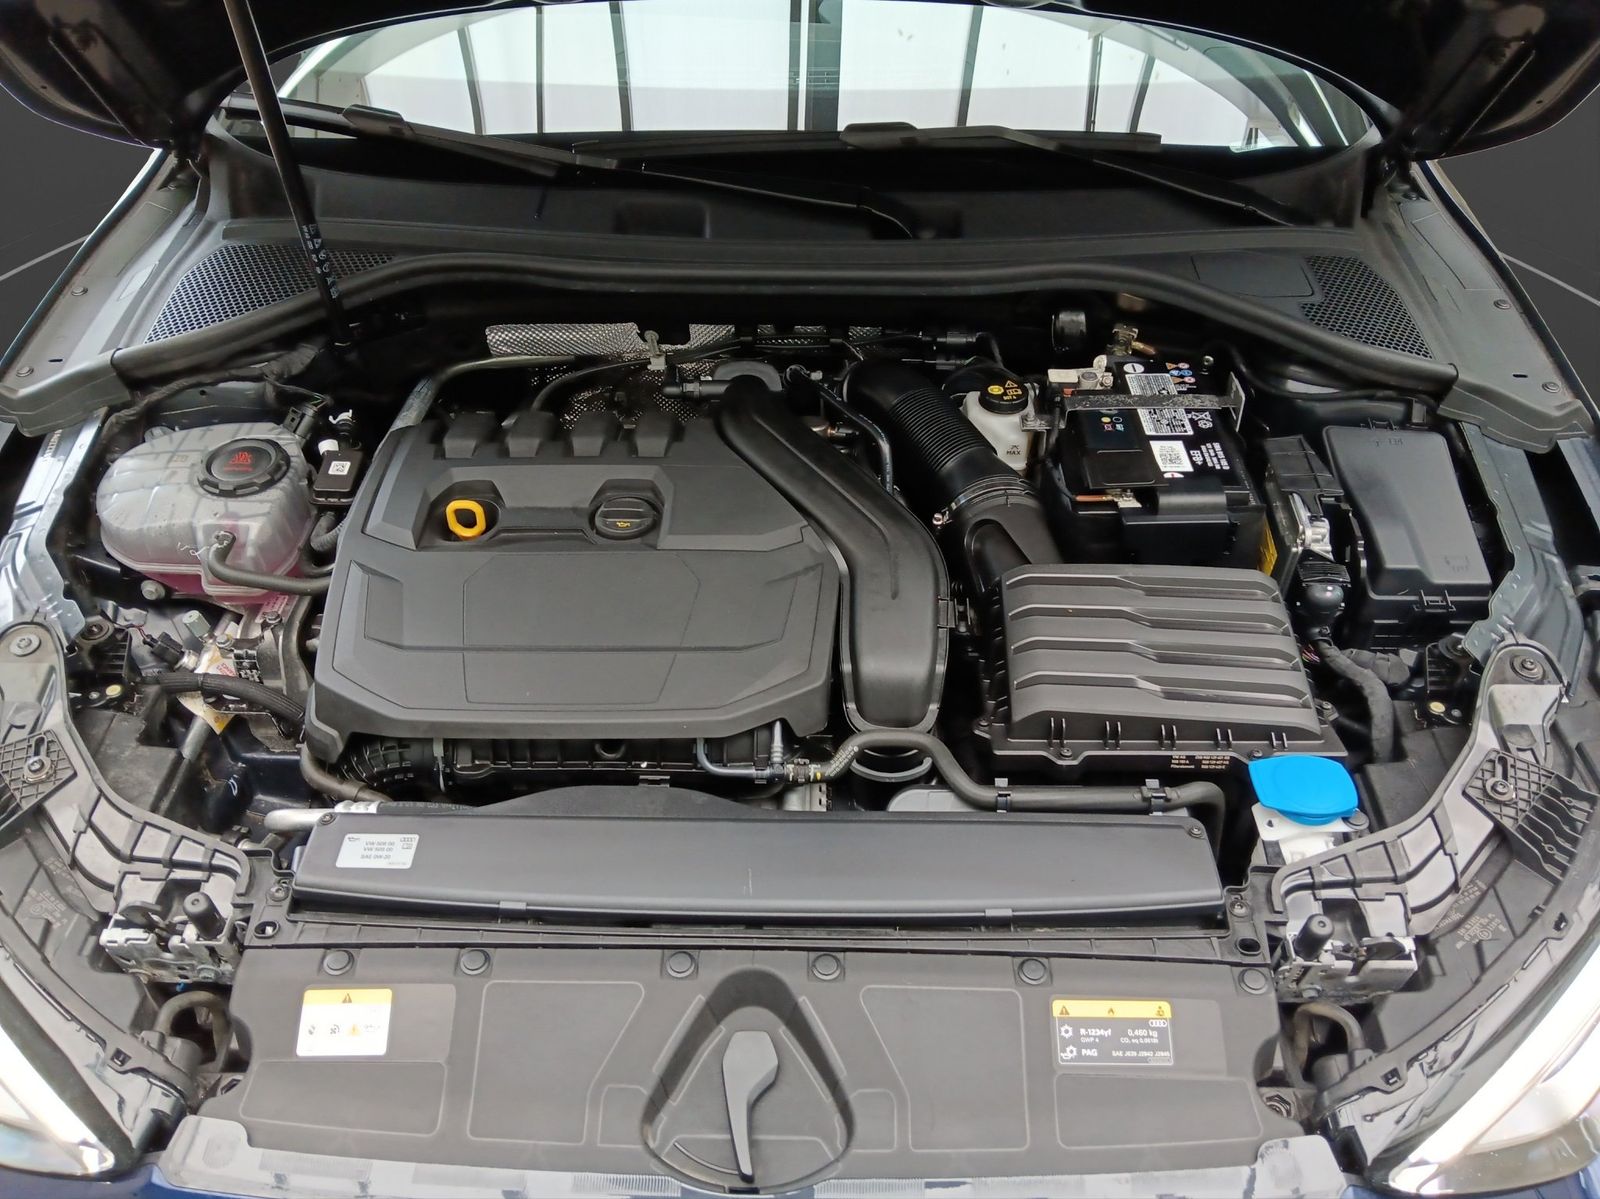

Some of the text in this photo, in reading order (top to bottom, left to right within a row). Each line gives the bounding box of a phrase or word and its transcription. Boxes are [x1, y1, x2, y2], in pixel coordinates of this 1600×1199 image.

[1080, 1028, 1112, 1038] R-1234yf
[1149, 1029, 1158, 1038] kg
[1081, 1048, 1098, 1057] PAG
